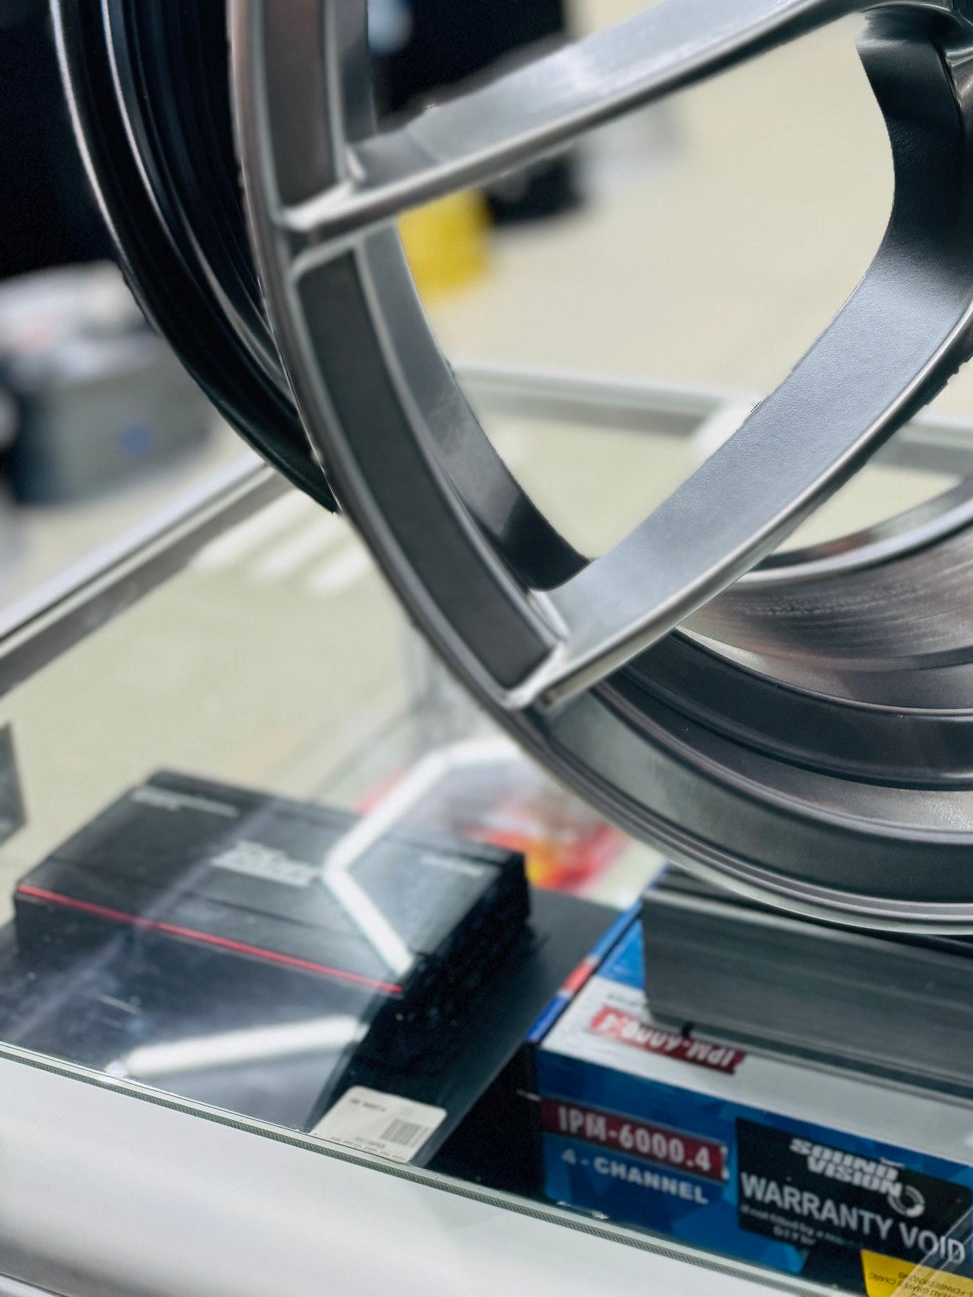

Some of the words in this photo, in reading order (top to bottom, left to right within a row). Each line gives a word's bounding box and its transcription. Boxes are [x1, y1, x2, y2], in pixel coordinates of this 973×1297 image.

[557, 1104, 712, 1172] IPM-6000.4
[788, 1137, 901, 1182] SOUND
[805, 1156, 904, 1198] VISION
[739, 1170, 895, 1241] WARRANTY
[898, 1223, 967, 1265] VOID
